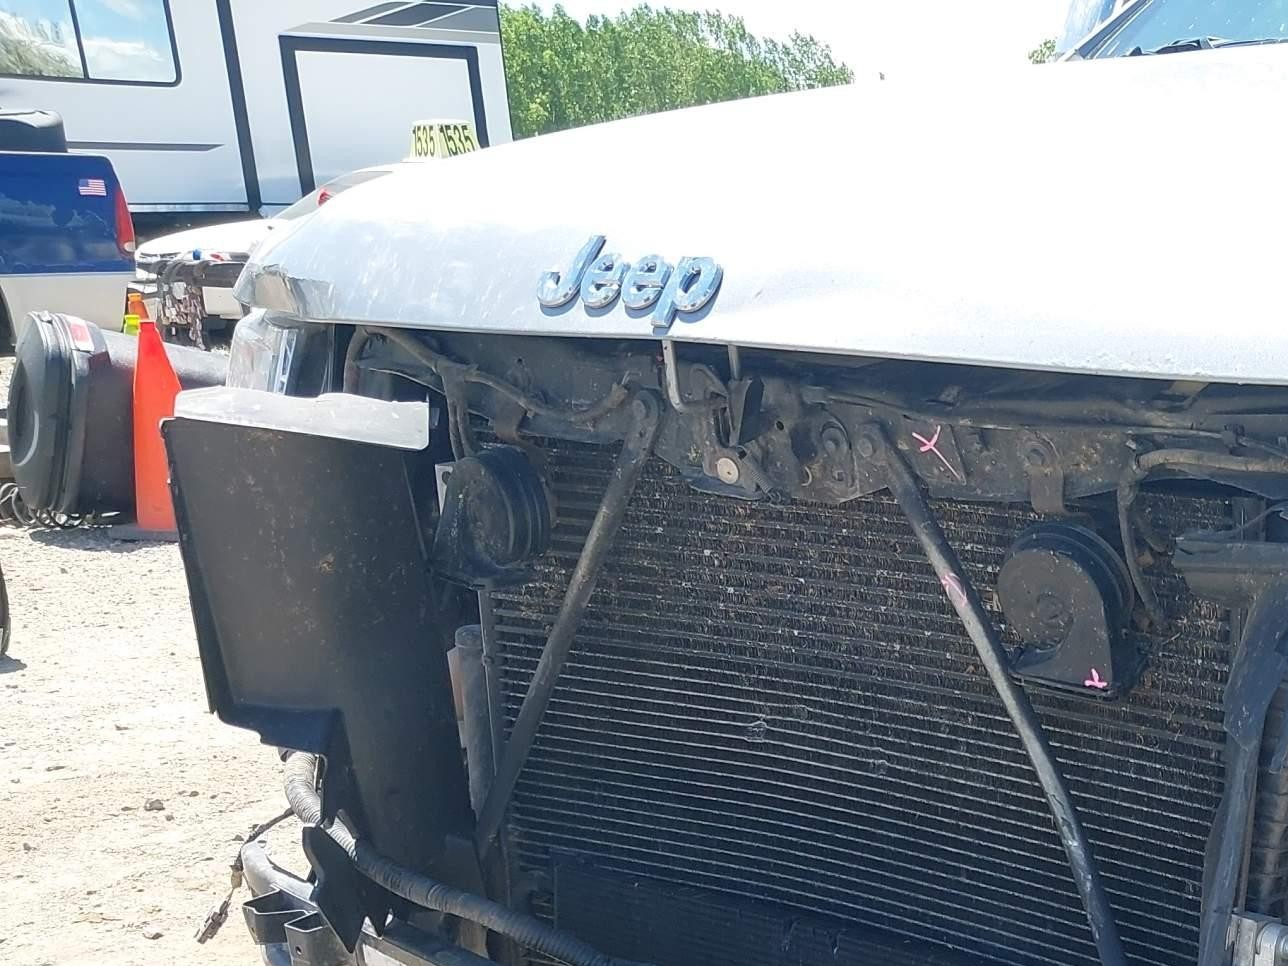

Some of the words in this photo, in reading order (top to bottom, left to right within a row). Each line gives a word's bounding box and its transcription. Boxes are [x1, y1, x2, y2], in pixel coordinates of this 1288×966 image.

[412, 125, 436, 157] 1535
[439, 124, 476, 157] 1535
[537, 235, 723, 328] Jeep
